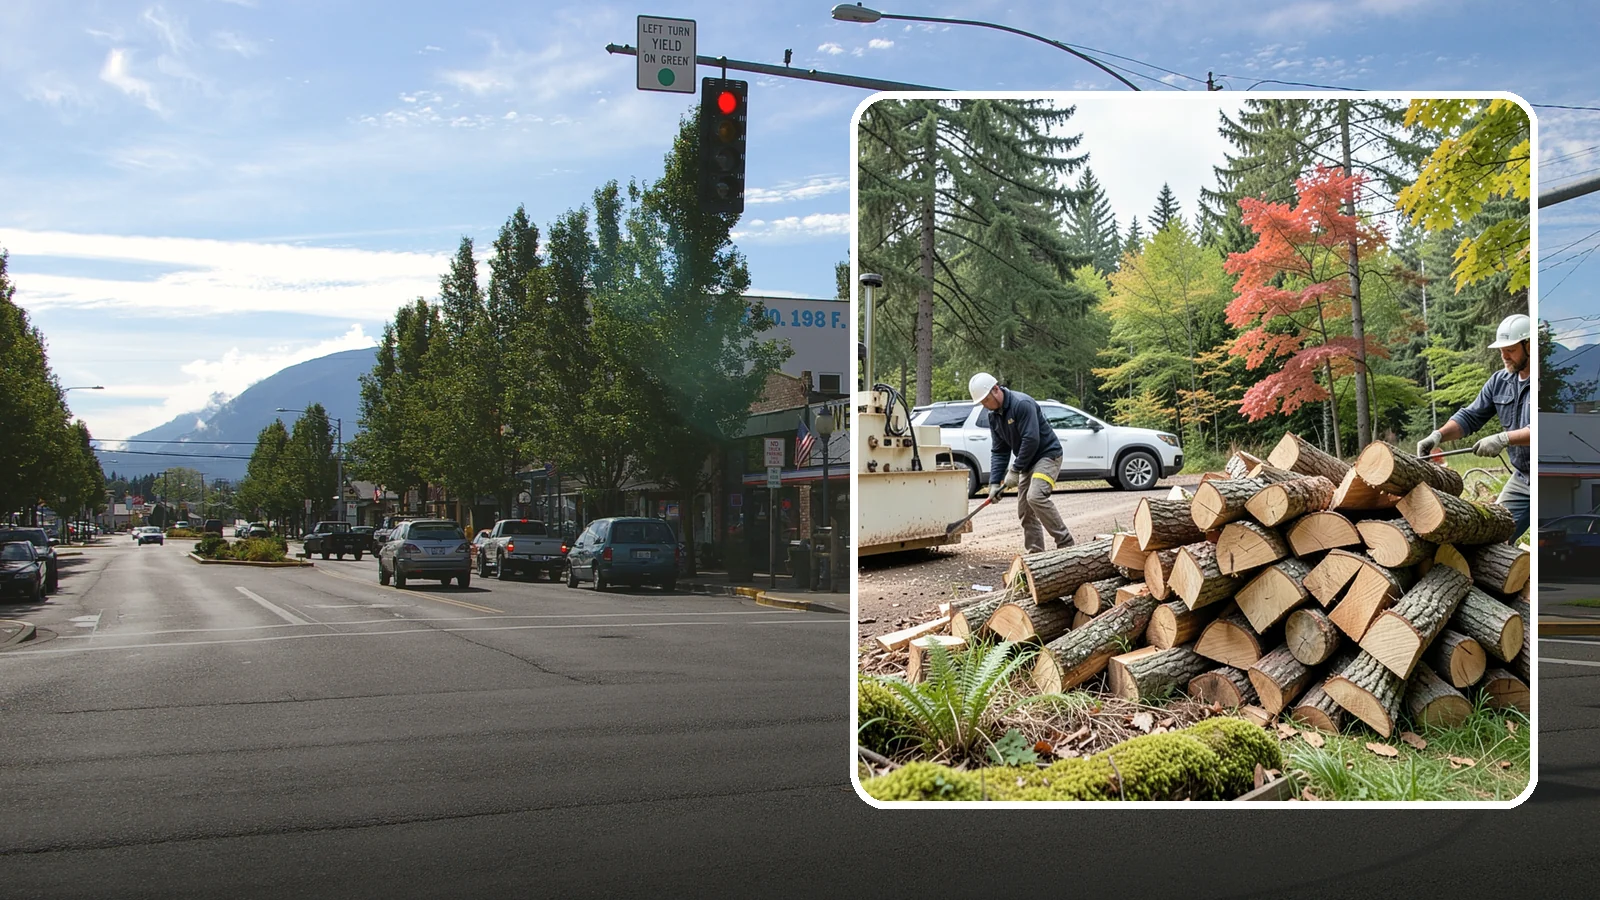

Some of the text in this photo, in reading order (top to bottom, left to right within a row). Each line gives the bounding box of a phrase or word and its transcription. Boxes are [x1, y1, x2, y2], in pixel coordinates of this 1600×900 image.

[643, 24, 690, 36] LEFT TURN
[652, 38, 682, 52] YIELD
[644, 54, 688, 66] ON GREEN
[791, 310, 826, 328] 198
[832, 311, 846, 329] F.
